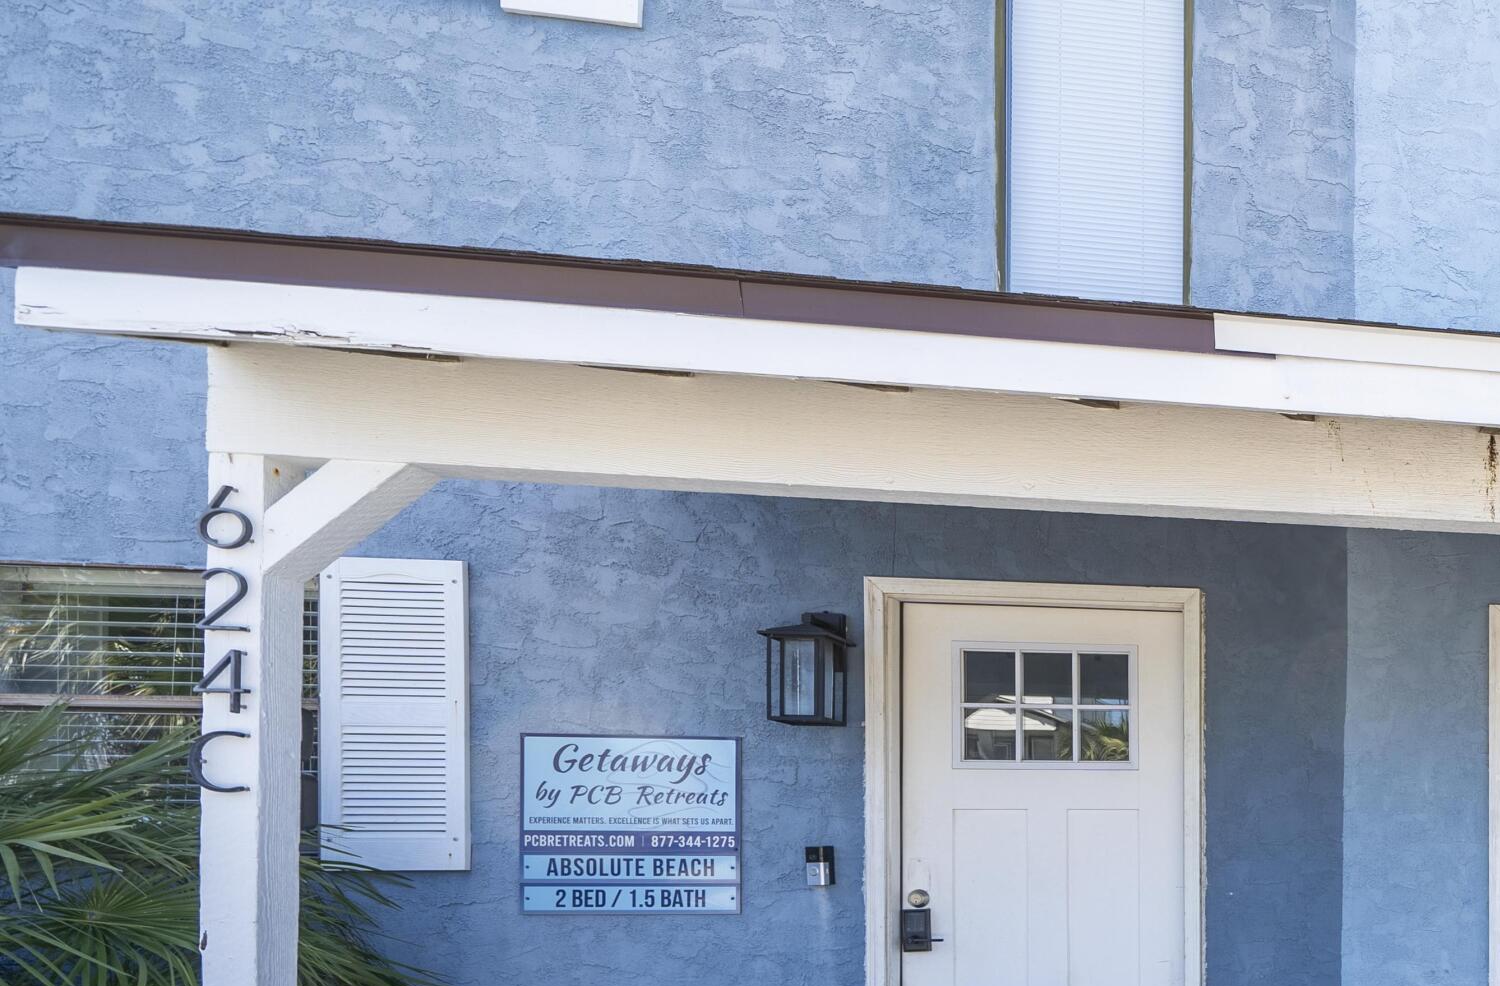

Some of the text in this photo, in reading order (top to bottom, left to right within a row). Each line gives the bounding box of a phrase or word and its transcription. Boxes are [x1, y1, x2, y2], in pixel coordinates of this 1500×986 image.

[189, 485, 254, 792] 624C
[552, 743, 712, 784] Getaways
[535, 780, 729, 808] by PCB Retreats
[528, 816, 734, 826] EXPERIENCE MATTERS. EXCELLENCE IS WHAT SETS US APART.
[524, 834, 736, 848] PCBRETREATS.COM 877-344-1275
[546, 857, 715, 877] ABSOLUTE BEACH
[555, 889, 706, 908] 2 BED / 1.5 BATH
